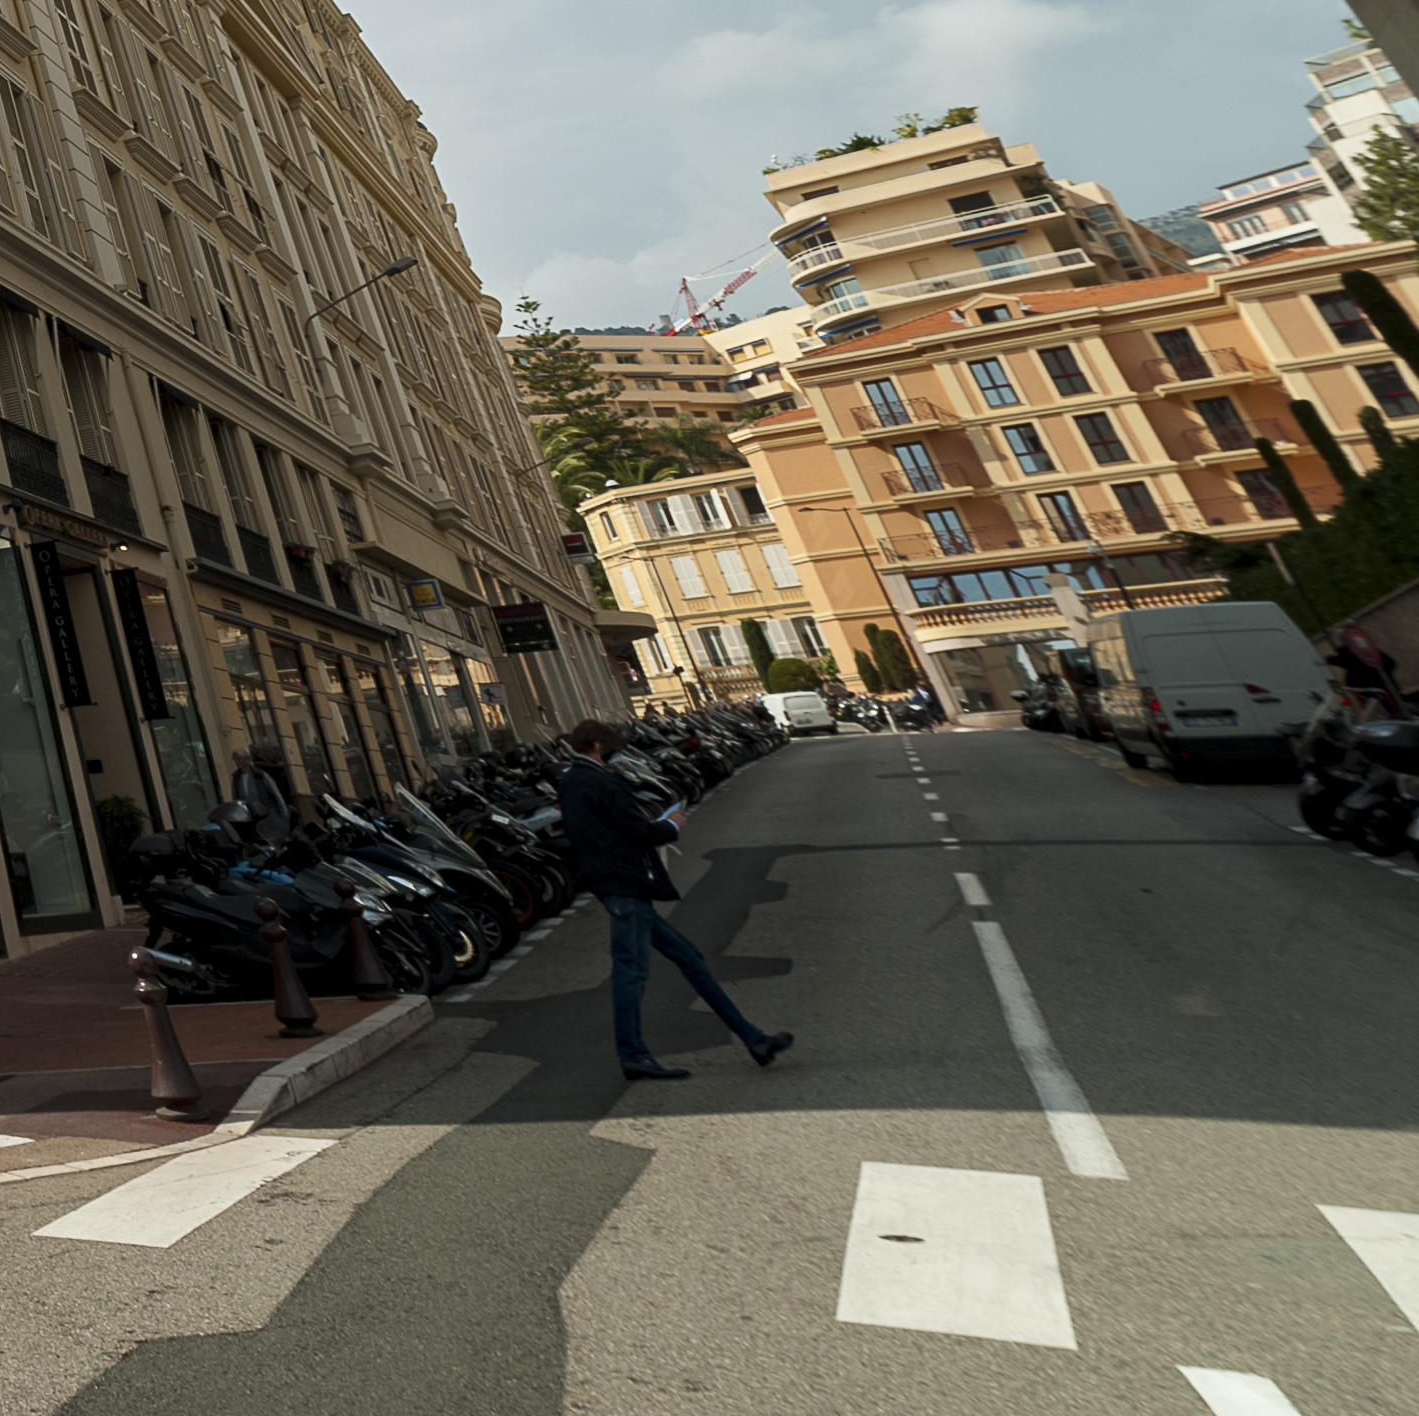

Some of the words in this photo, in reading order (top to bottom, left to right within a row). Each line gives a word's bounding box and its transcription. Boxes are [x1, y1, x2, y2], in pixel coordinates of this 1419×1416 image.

[23, 504, 61, 532] OPERA
[38, 549, 62, 610] OPERA
[54, 615, 80, 699] GALLERY
